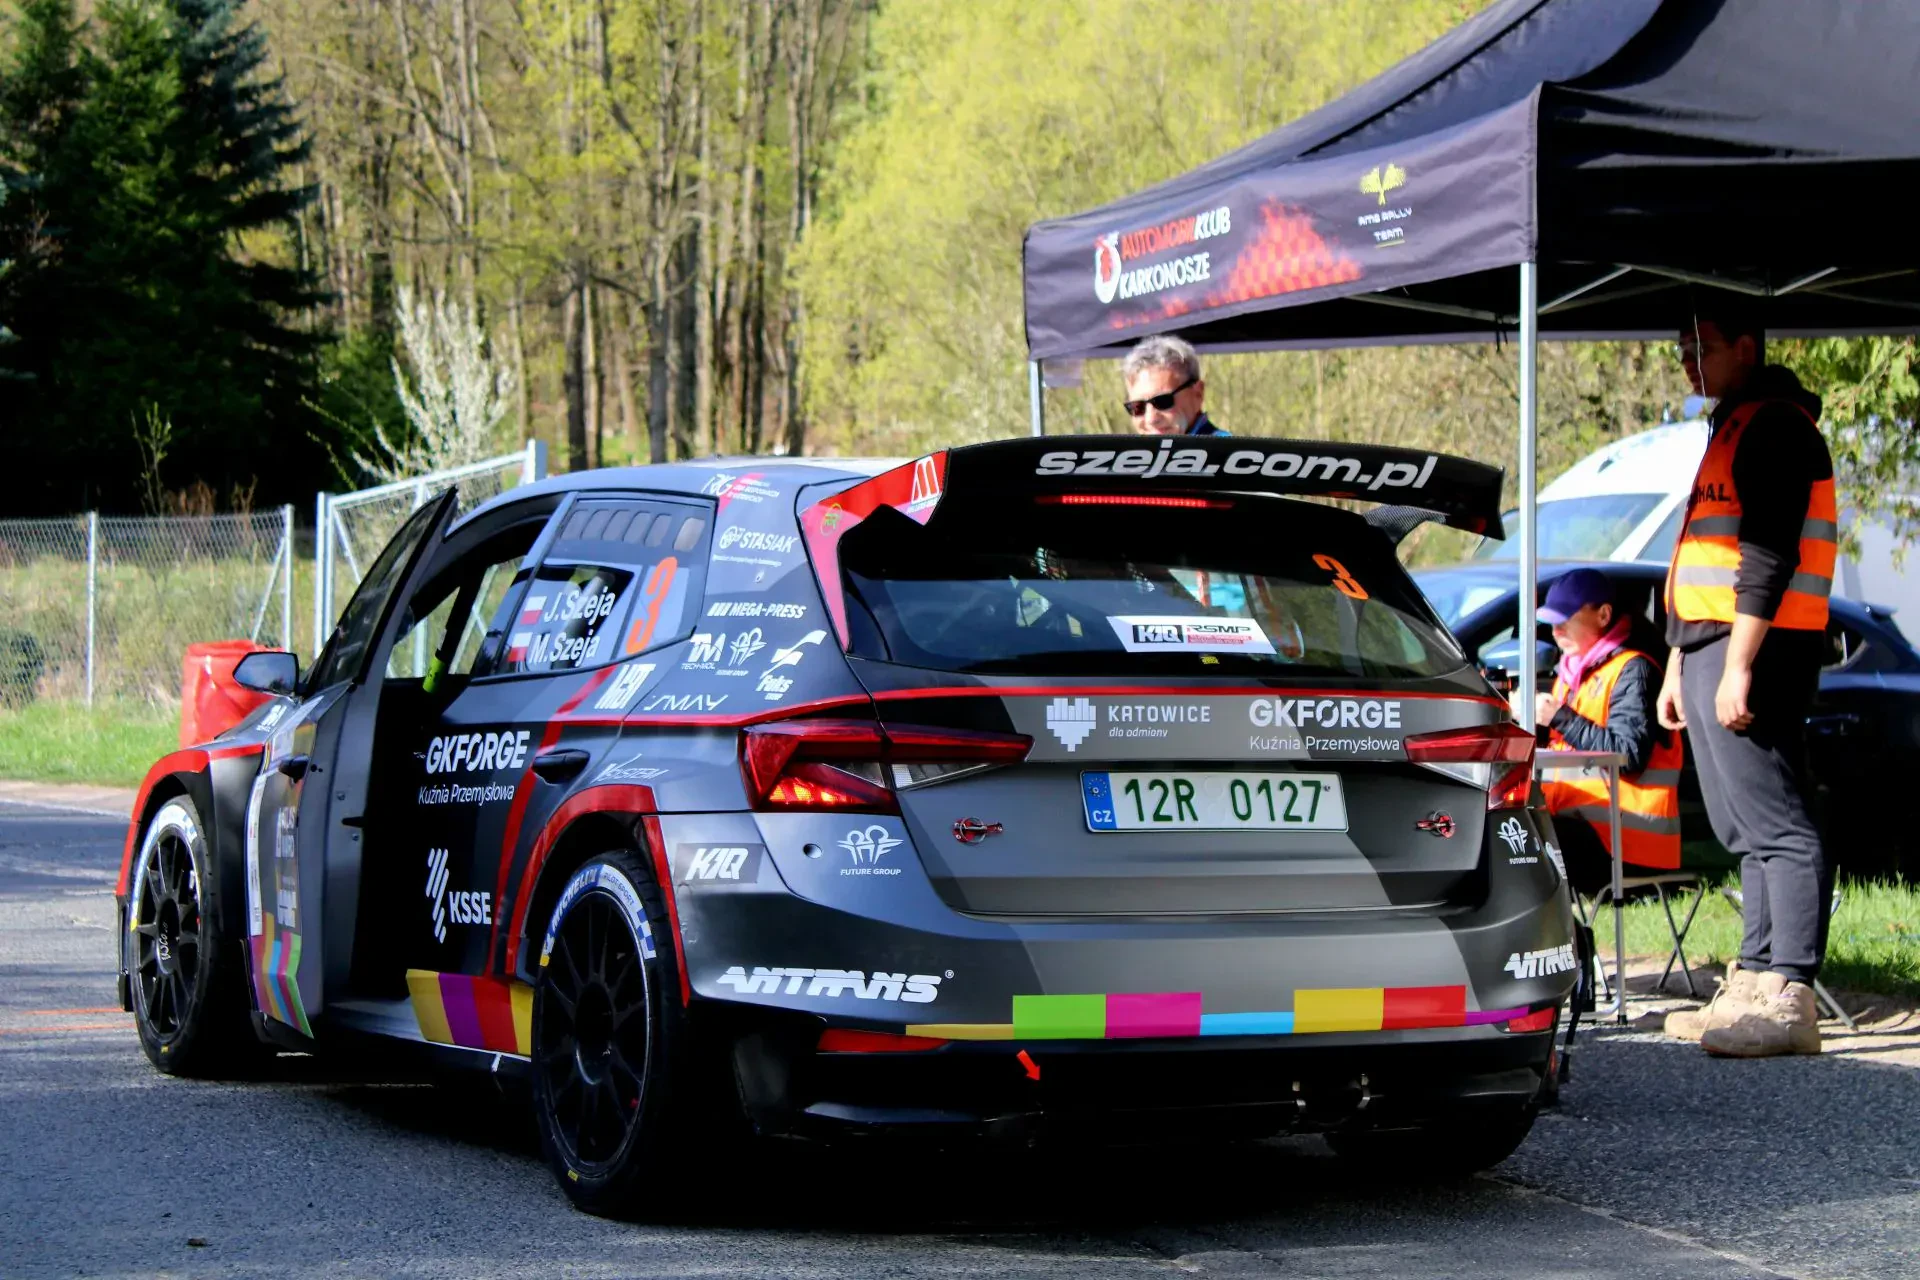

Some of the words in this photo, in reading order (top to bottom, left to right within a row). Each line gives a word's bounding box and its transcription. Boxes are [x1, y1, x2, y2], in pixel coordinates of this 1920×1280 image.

[1119, 252, 1210, 299] KARKONOSZE
[1035, 439, 1438, 491] szeja.com.pl
[740, 531, 799, 553] STASIAK
[1312, 554, 1369, 600] 3
[626, 556, 678, 655] 3
[729, 602, 807, 618] MEGA-PRESS
[1187, 624, 1252, 634] RSMP
[1108, 705, 1212, 723] KATOWICE
[1249, 699, 1402, 729] GKFORGE
[1109, 727, 1125, 737] dla
[1126, 727, 1169, 738] odmiany
[1250, 735, 1301, 751] Kuźnia
[1305, 735, 1401, 754] Przemysłowa
[426, 730, 531, 774] GKFORGE
[418, 786, 449, 805] Kuźnia
[450, 781, 515, 806] Przemysłowa
[1124, 778, 1199, 822] 12R
[1229, 778, 1323, 823] 0127
[1092, 810, 1113, 824] CZ
[840, 868, 872, 876] FUTURE
[873, 868, 901, 876] GROUP
[449, 890, 492, 925] KSSE
[552, 868, 599, 933] MICHELIN
